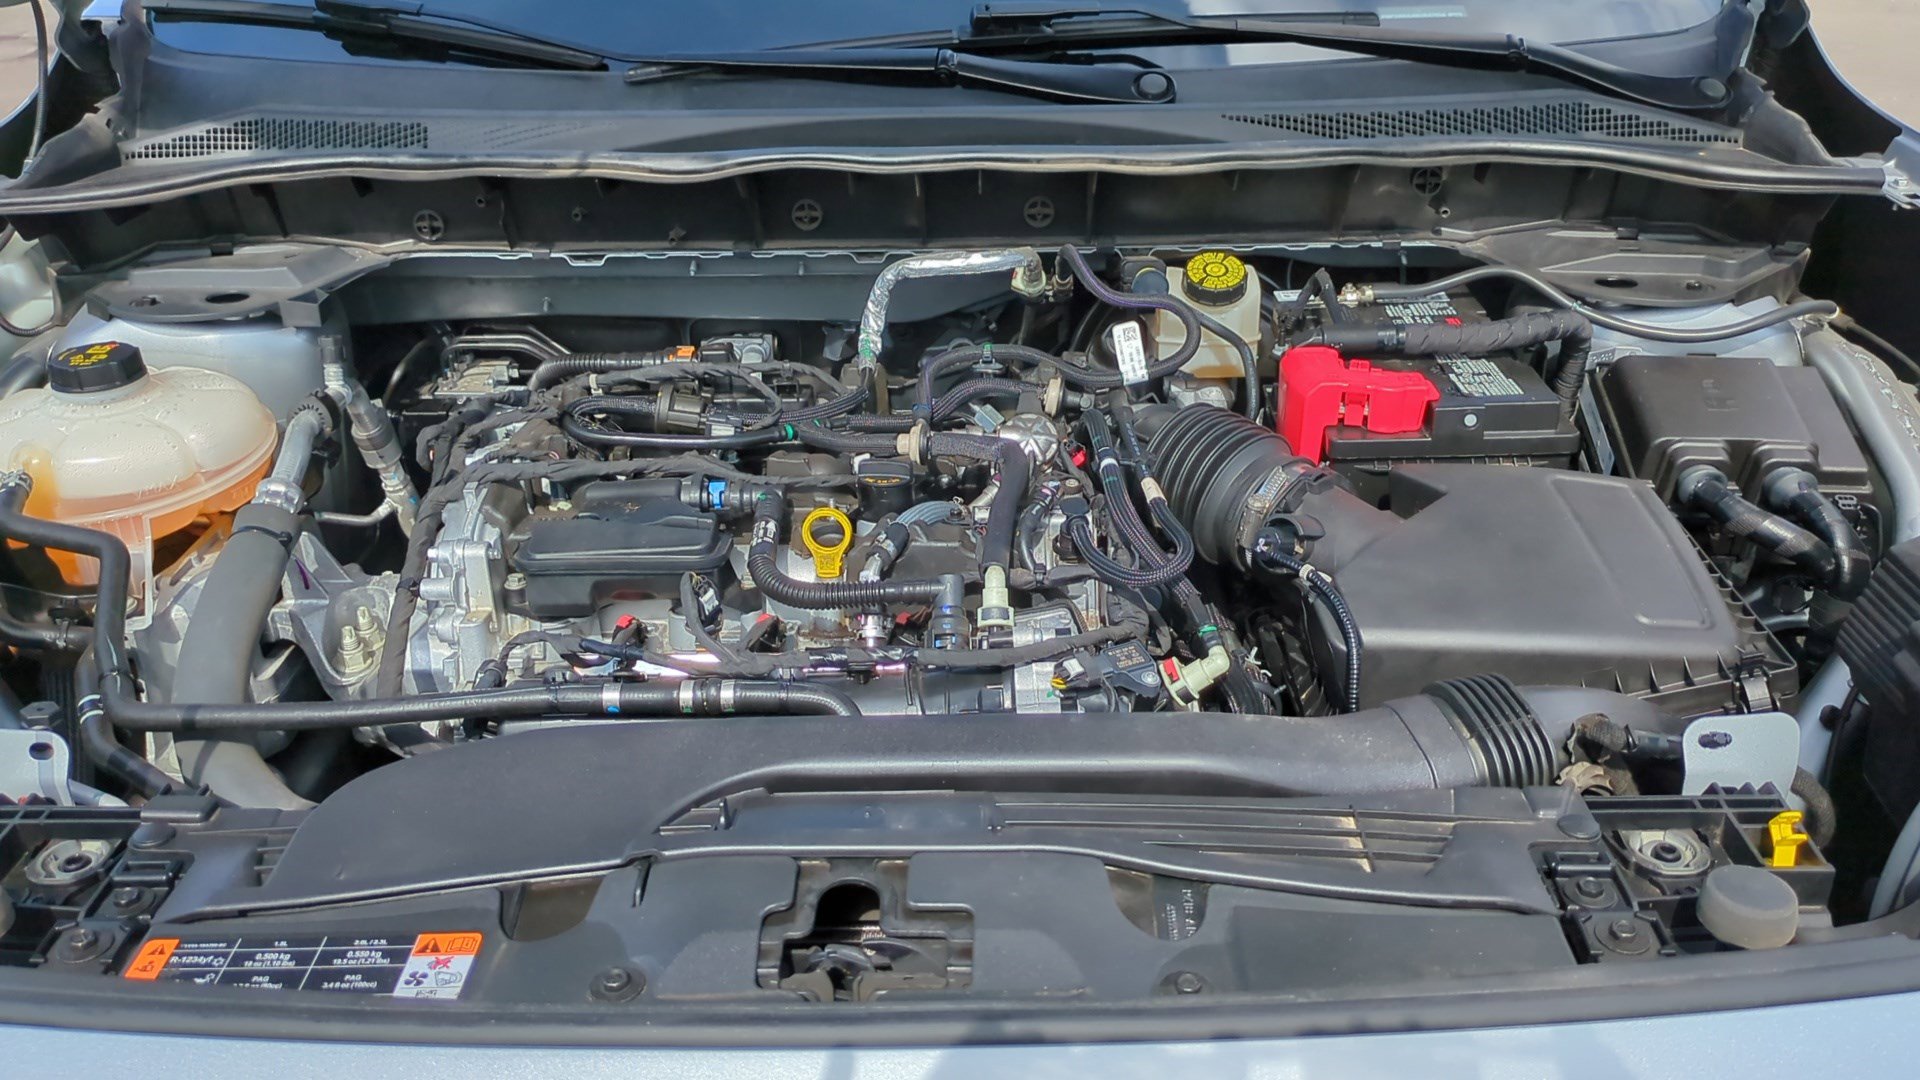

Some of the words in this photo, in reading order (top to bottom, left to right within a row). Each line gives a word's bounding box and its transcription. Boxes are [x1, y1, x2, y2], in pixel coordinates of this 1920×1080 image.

[255, 952, 279, 960] 0.500
[279, 952, 291, 961] kg
[346, 950, 370, 959] 0.550
[370, 950, 382, 959] kg
[169, 955, 214, 964] R-1234yf
